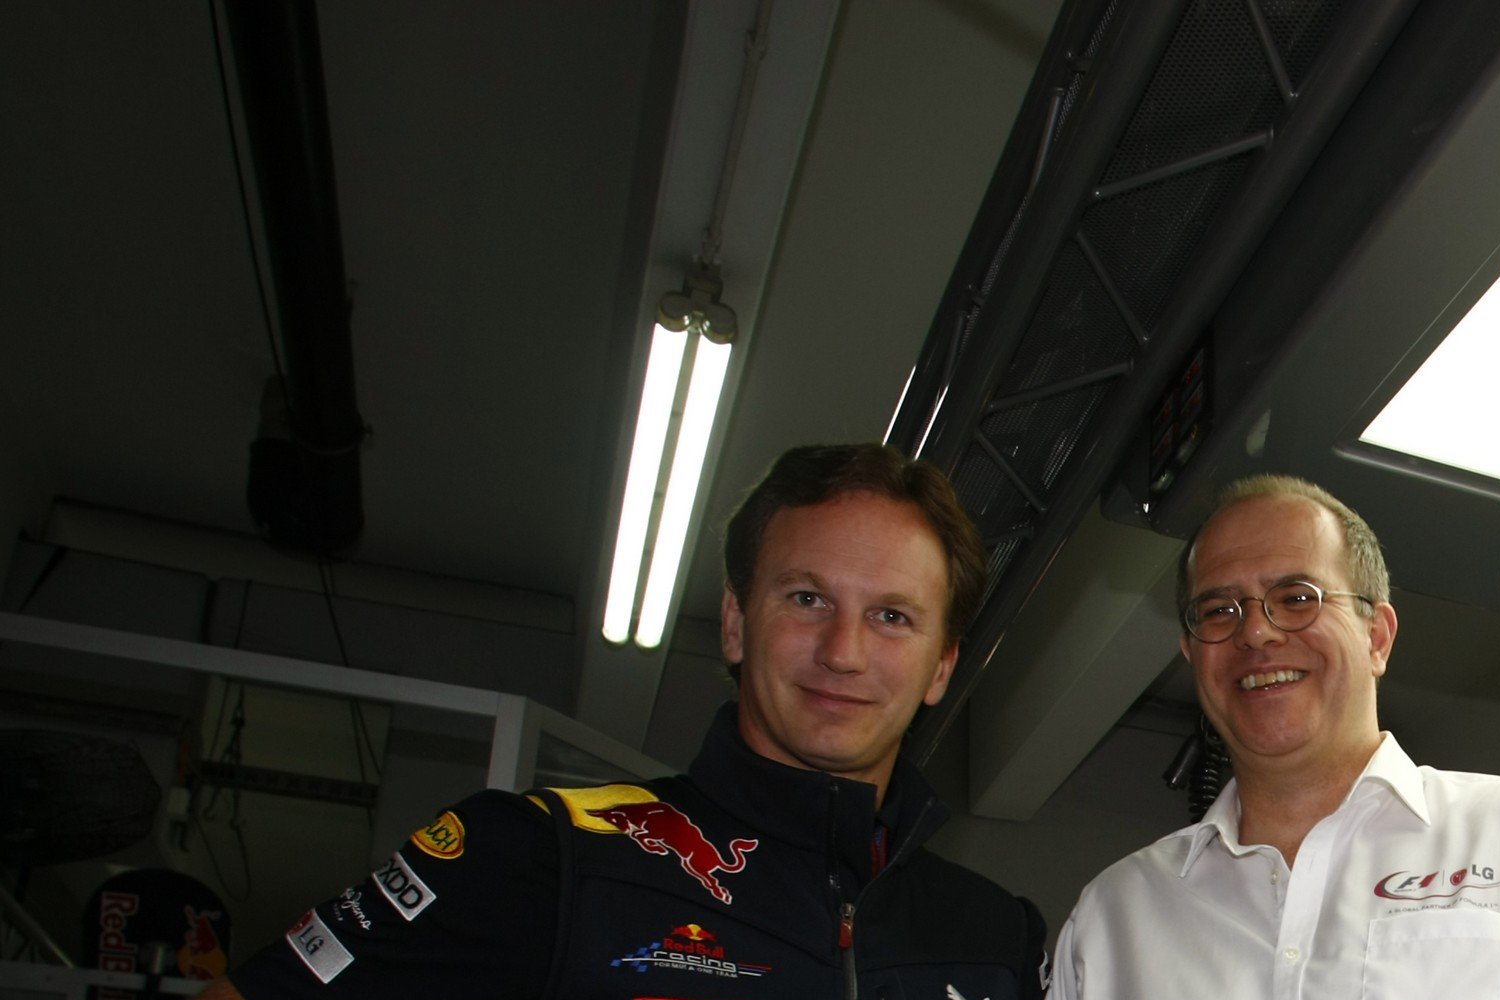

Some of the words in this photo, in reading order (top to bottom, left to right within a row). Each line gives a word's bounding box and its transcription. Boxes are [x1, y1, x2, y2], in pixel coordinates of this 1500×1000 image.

[425, 823, 457, 851] UCH
[377, 857, 424, 909] XDD
[1471, 864, 1494, 880] LG
[99, 890, 140, 953] Red
[298, 926, 324, 956] LG
[663, 936, 694, 953] Red
[696, 942, 725, 960] Bull
[653, 951, 737, 973] racing
